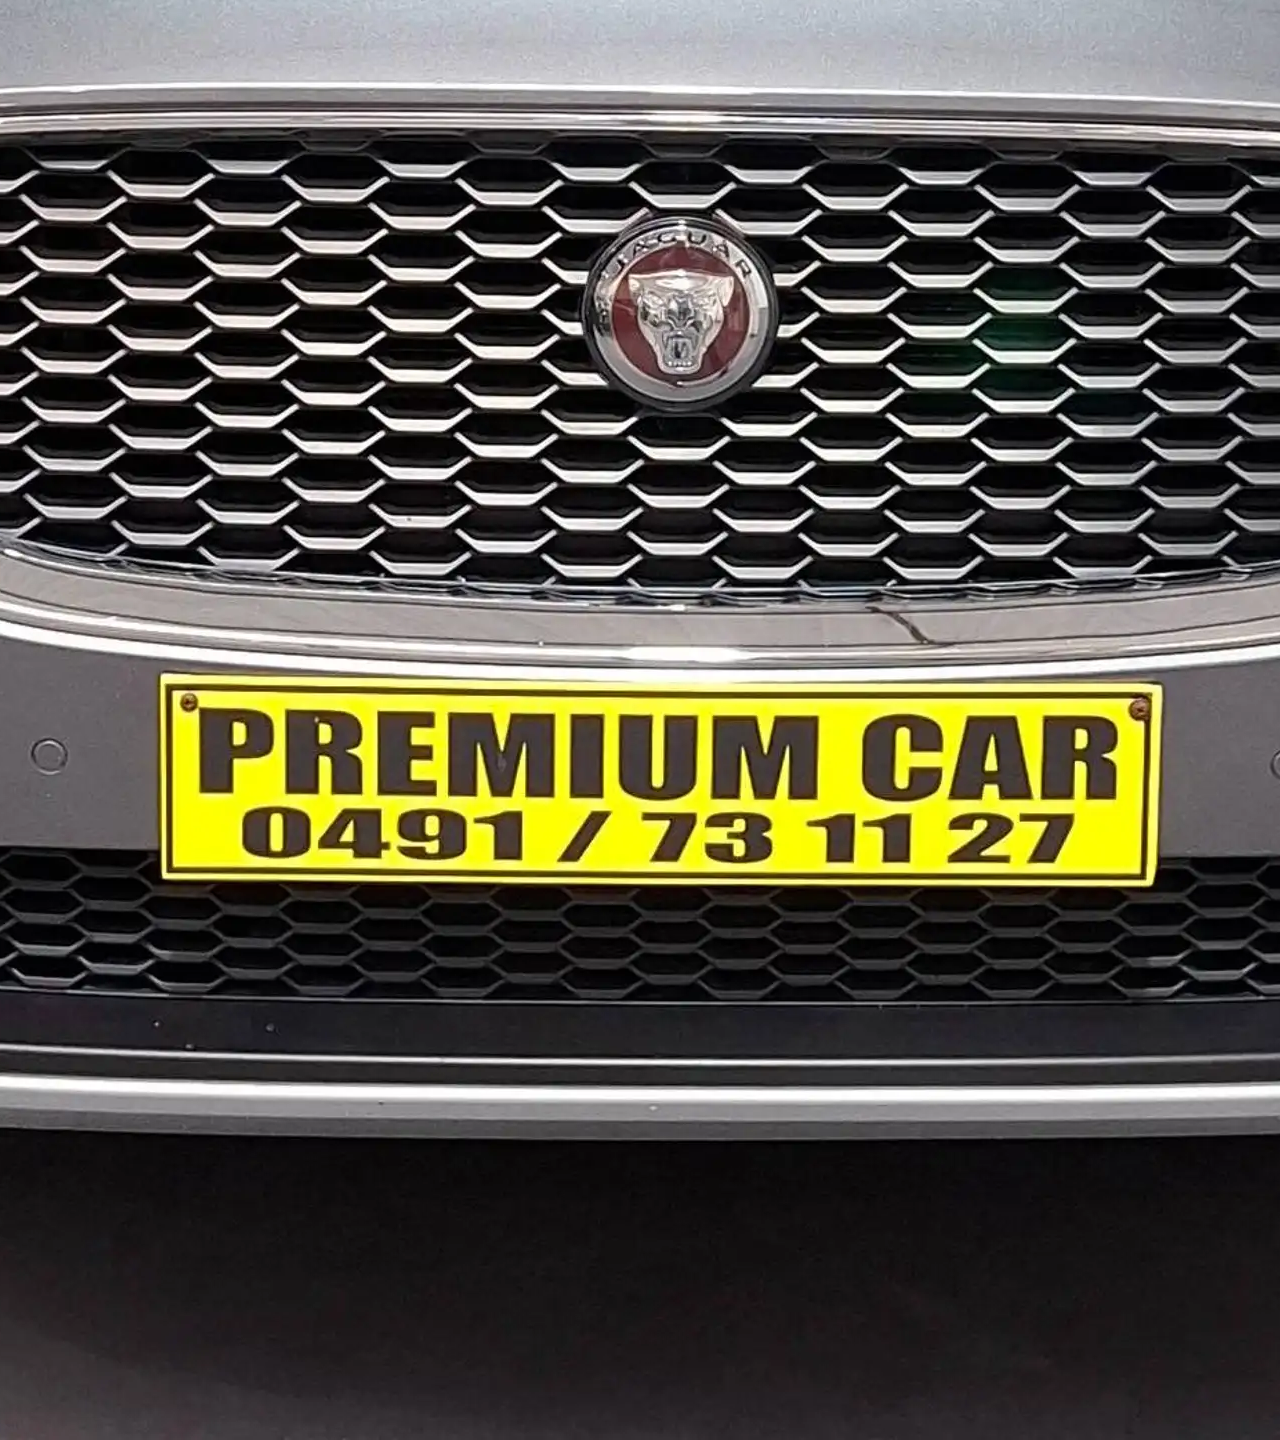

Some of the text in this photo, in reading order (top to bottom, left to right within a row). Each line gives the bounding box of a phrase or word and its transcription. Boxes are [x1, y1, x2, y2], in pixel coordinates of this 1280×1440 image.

[198, 707, 1119, 802] PREMIUM CAR
[241, 806, 1075, 864] 0491 / 73 11 27
